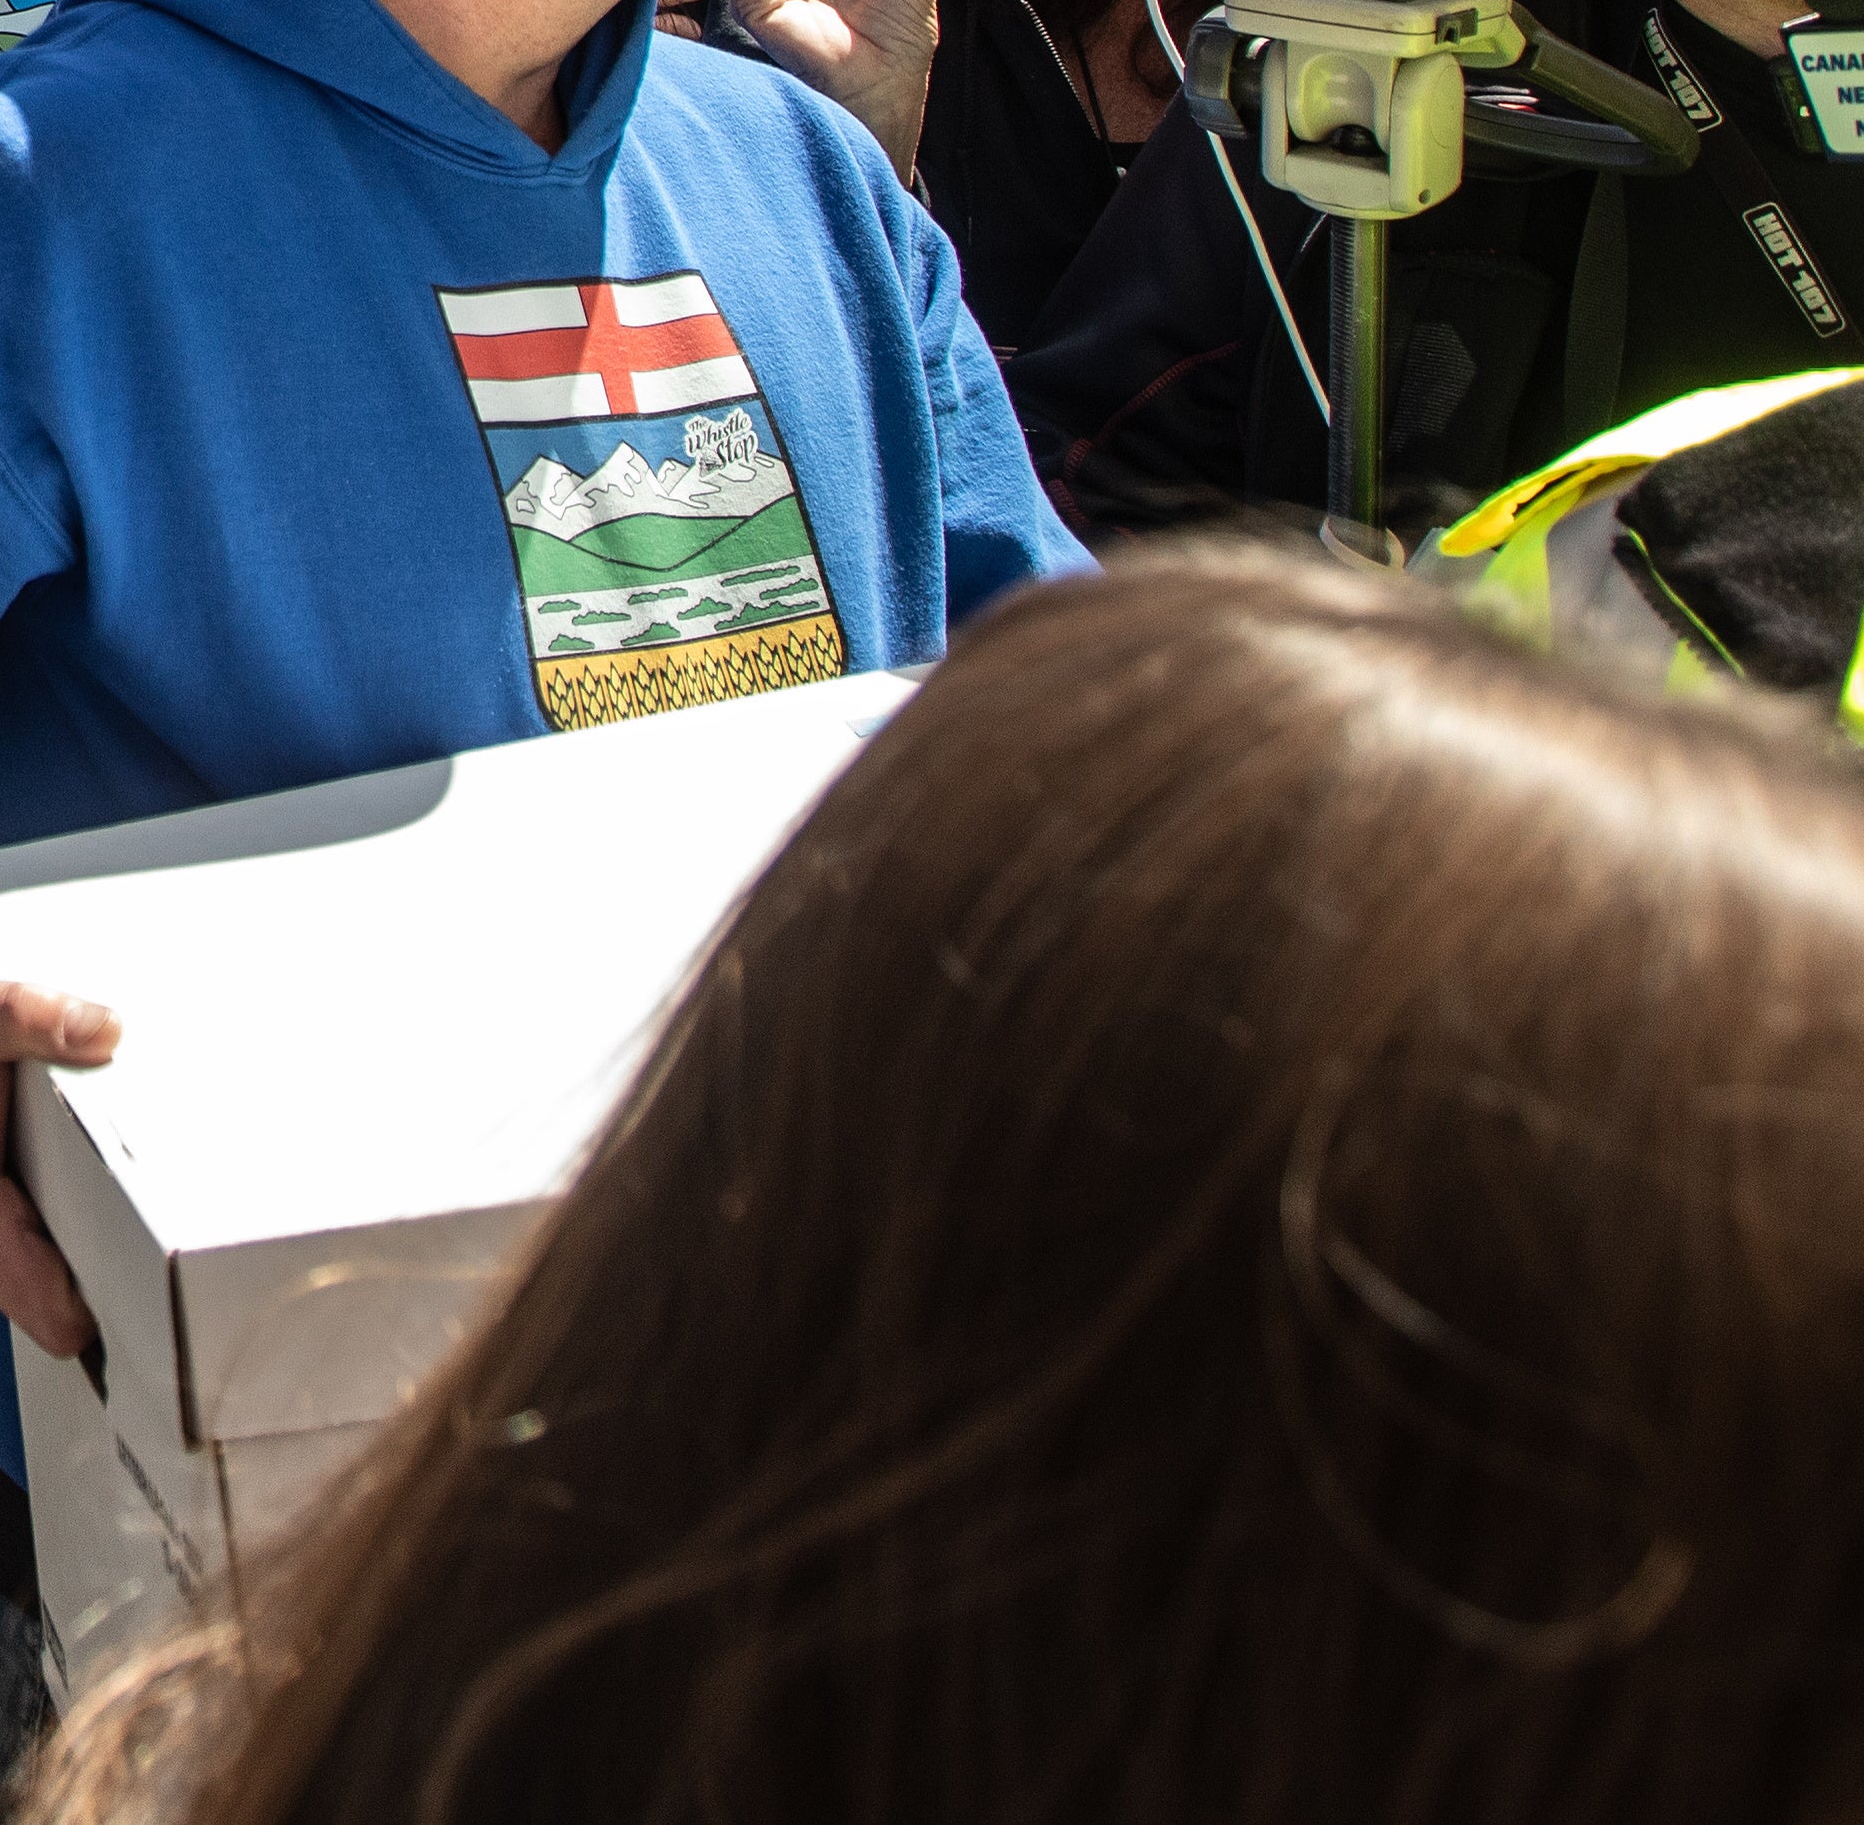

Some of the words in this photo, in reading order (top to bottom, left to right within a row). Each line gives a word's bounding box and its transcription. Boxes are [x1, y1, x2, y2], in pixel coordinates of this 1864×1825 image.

[1752, 211, 1804, 269] HOT
[1791, 269, 1838, 324] 107
[687, 411, 749, 454] Whistle
[688, 419, 708, 432] The
[715, 434, 755, 469] Stop
